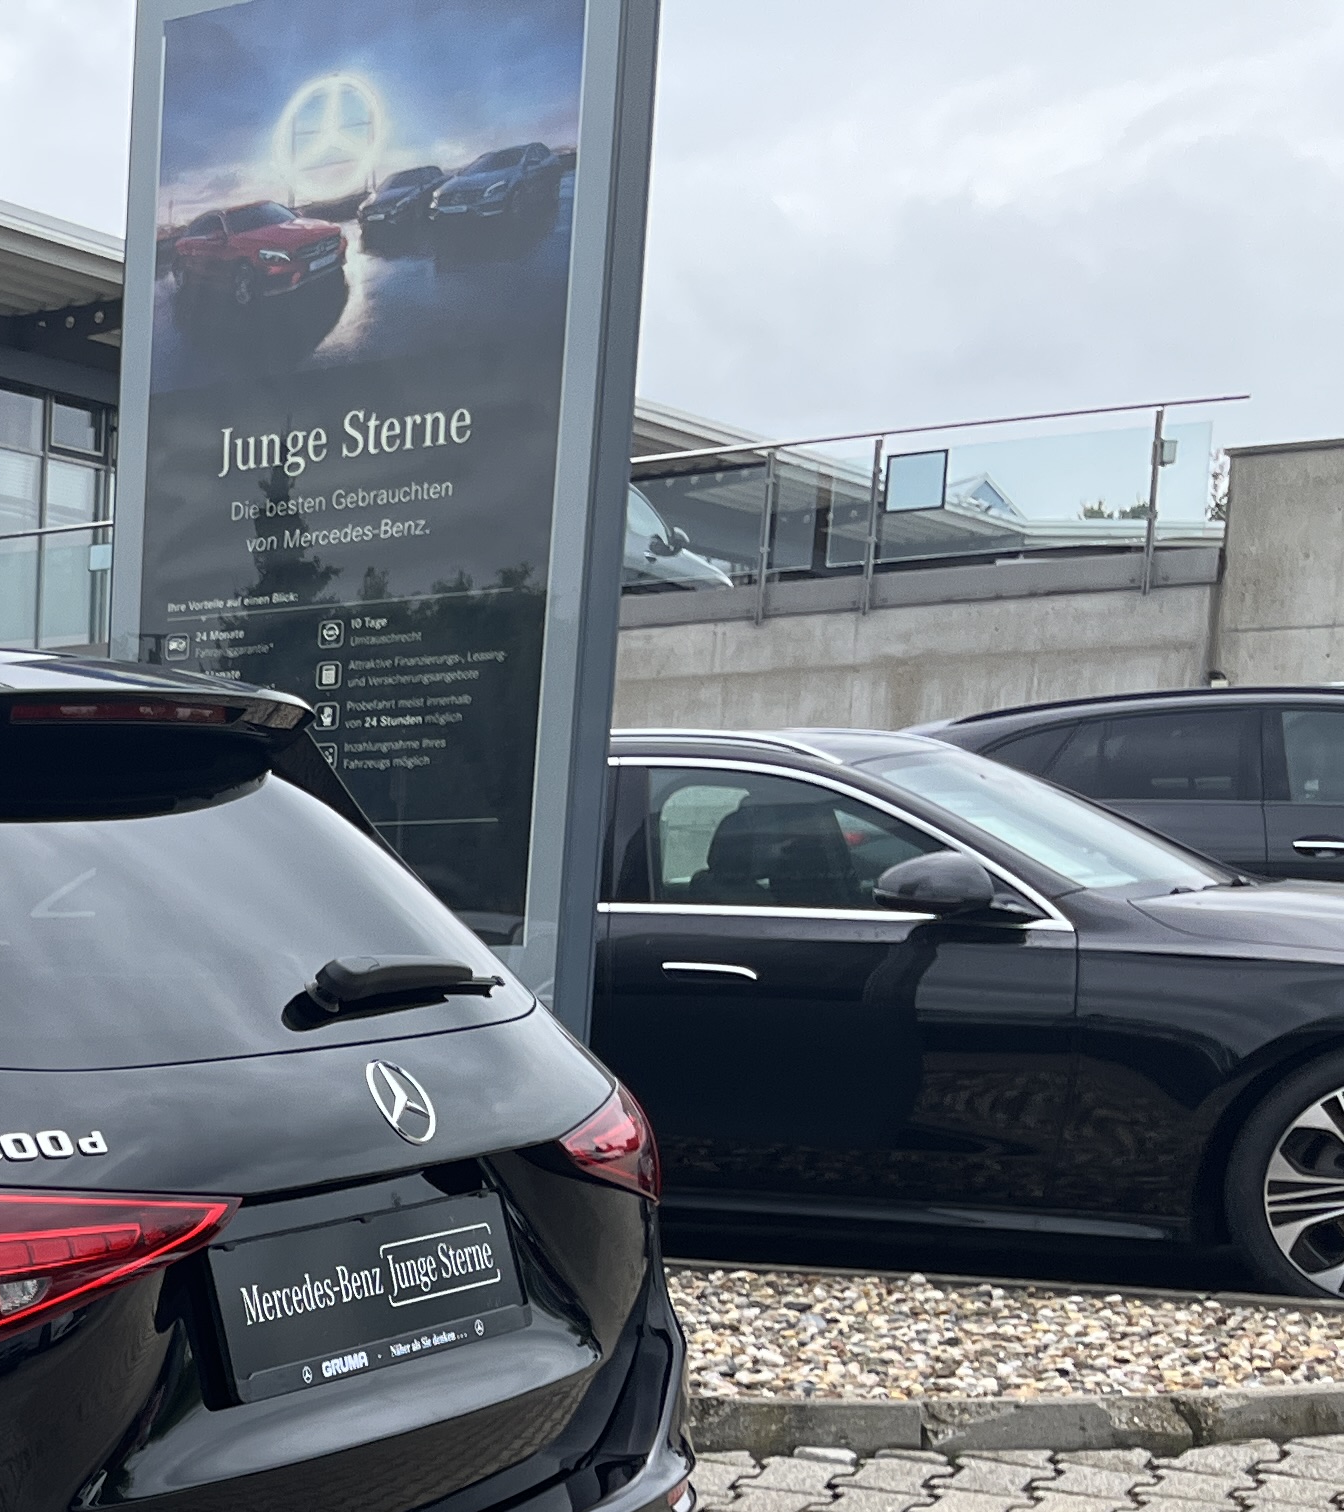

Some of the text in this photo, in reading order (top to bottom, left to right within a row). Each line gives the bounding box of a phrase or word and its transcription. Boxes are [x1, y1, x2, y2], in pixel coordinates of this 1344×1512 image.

[218, 408, 471, 477] Junge Sterne
[230, 480, 454, 521] Die besten Gebrauchten
[246, 518, 431, 552] von Mercedes-Benz.
[167, 602, 187, 613] Ihre
[188, 599, 224, 611] Vorteile
[226, 596, 242, 608] auf
[243, 595, 270, 606] einen
[195, 630, 245, 642] 24 Monate
[364, 616, 388, 630] Tage
[364, 716, 377, 728] 24
[379, 713, 423, 727] Stunden
[240, 1242, 495, 1326] Mercedes-Benz Junge Sterne
[321, 1351, 369, 1378] GRUMA
